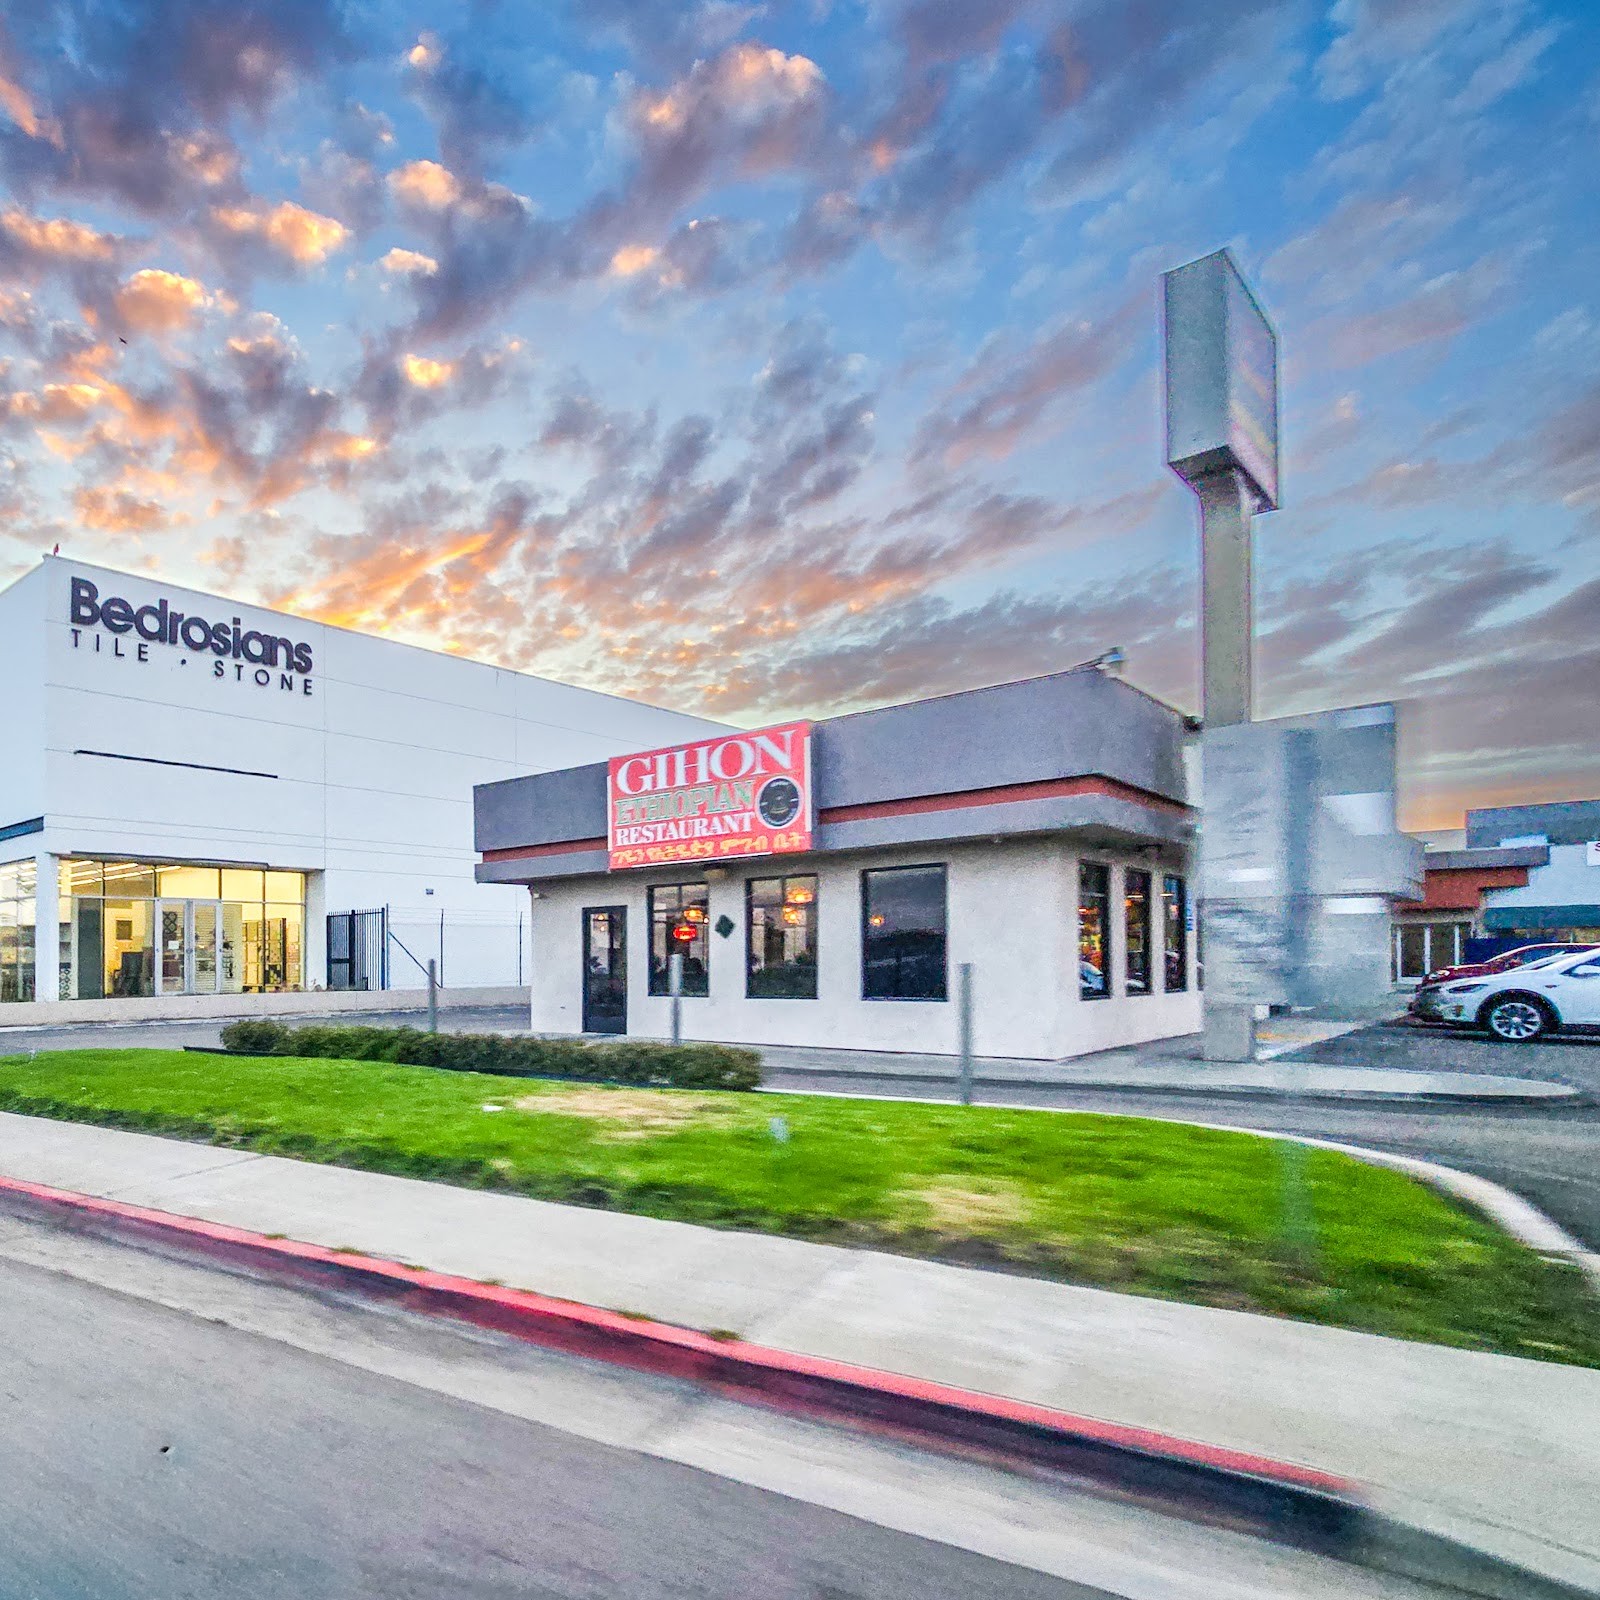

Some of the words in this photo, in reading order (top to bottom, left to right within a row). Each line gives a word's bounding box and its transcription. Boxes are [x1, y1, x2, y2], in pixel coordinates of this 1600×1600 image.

[70, 576, 313, 674] Bedrosians
[71, 628, 149, 662] TILE
[213, 660, 313, 696] STONE
[616, 729, 797, 795] GIHON
[615, 779, 756, 826] ETHIOPIAN
[615, 811, 756, 847] RESTAURANT
